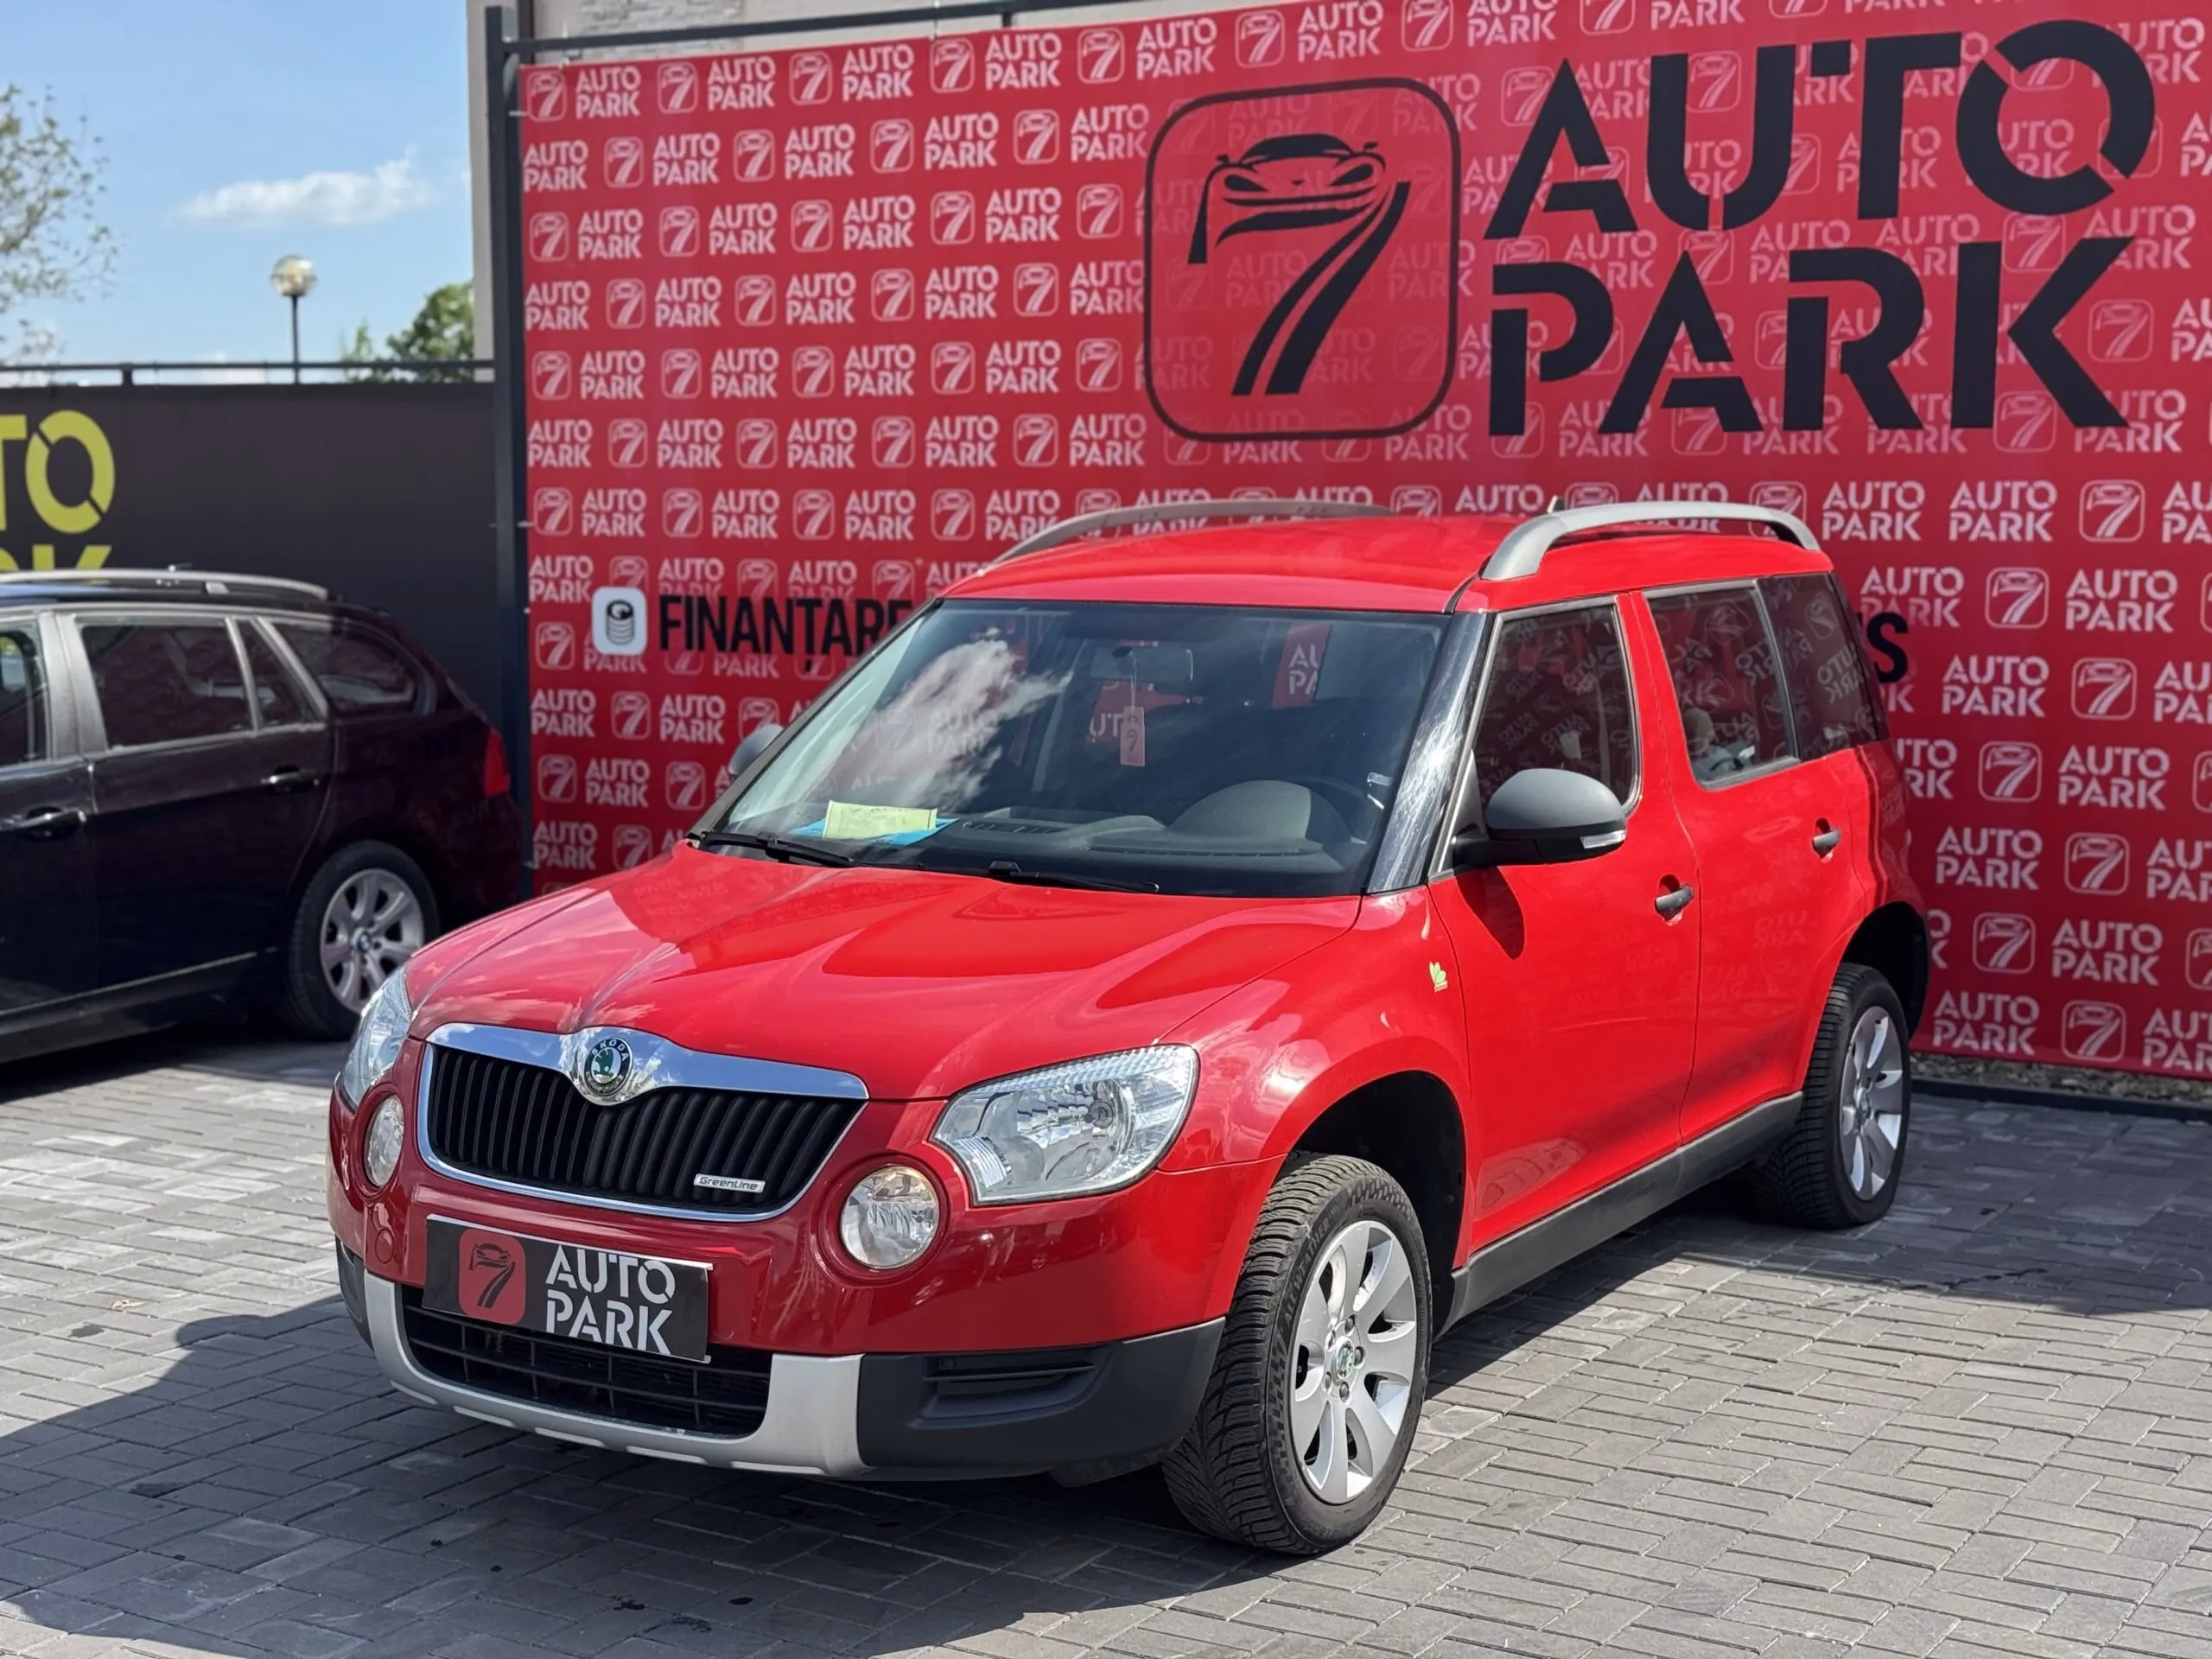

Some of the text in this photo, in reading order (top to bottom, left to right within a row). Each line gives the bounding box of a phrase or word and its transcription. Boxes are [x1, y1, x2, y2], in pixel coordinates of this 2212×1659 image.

[1298, 0, 1382, 36] AUTO
[1468, 10, 1555, 46] PARK
[1650, 1, 1745, 29] PARK
[985, 34, 1061, 62] AUTO
[1136, 18, 1217, 52] AUTO
[1298, 27, 1381, 62] PARK
[708, 57, 776, 85] AUTO
[842, 45, 914, 73] AUTO
[1136, 44, 1216, 79] PARK
[575, 66, 641, 92] AUTO
[842, 73, 914, 101] PARK
[985, 60, 1060, 90] PARK
[575, 91, 641, 118] PARK
[708, 81, 776, 111] PARK
[924, 112, 999, 142] AUTO
[1071, 104, 1148, 133] AUTO
[1483, 19, 2155, 240] AUTO
[653, 133, 720, 161] AUTO
[785, 124, 855, 152] AUTO
[1071, 131, 1147, 162] PARK
[1997, 119, 2074, 151] UTO
[523, 140, 588, 167] AUTO
[785, 150, 855, 180] PARK
[924, 142, 997, 171] PARK
[523, 166, 588, 192] PARK
[653, 159, 719, 187] PARK
[843, 195, 915, 223] AUTO
[985, 187, 1061, 215] AUTO
[578, 210, 643, 235] AUTO
[709, 203, 777, 229] AUTO
[985, 213, 1060, 243] PARK
[1875, 213, 1980, 246] AUTO
[2084, 205, 2196, 237] AUTO
[578, 234, 643, 261] PARK
[709, 227, 777, 255] PARK
[843, 222, 915, 251] PARK
[1565, 232, 1656, 261] AUTO
[1751, 219, 1851, 251] AUTO
[925, 265, 999, 293] AUTO
[1071, 260, 1144, 289] AUTO
[1750, 253, 1789, 283] PA
[525, 281, 590, 308] AUTO
[656, 276, 722, 303] AUTO
[786, 271, 856, 298] AUTO
[656, 302, 721, 328] PARK
[786, 297, 855, 325] PARK
[925, 292, 997, 319] PARK
[1071, 287, 1144, 315] PARK
[2173, 298, 2212, 328] AU
[525, 305, 589, 331] PARK
[1489, 235, 2135, 436] PARK
[2171, 332, 2212, 362] PA
[581, 351, 645, 375] AUTO
[710, 348, 779, 374] AUTO
[844, 345, 915, 372] AUTO
[985, 341, 1061, 367] AUTO
[581, 375, 645, 399] PARK
[710, 373, 779, 399] PARK
[844, 371, 915, 397] PARK
[985, 366, 1060, 393] PARK
[527, 420, 593, 444] AUTO
[658, 418, 723, 442] AUTO
[787, 417, 856, 442] AUTO
[925, 415, 998, 440] AUTO
[1070, 414, 1146, 440] AUTO
[1743, 426, 1840, 454] PARK
[1867, 424, 1967, 454] PARK
[2075, 426, 2182, 454] PARK
[527, 443, 592, 468] PARK
[658, 442, 722, 468] PARK
[787, 442, 856, 468] PARK
[925, 441, 997, 467] PARK
[1070, 440, 1144, 467] PARK
[1224, 440, 1302, 464] PARK
[1384, 434, 1469, 461] PARK
[1560, 432, 1649, 458] PARK
[582, 489, 646, 513] AUTO
[712, 489, 779, 513] AUTO
[845, 489, 916, 515] AUTO
[986, 489, 1060, 515] AUTO
[1455, 484, 1544, 512] AUTO
[1822, 481, 1925, 511] AUTO
[1949, 480, 2056, 511] AUTO
[2162, 480, 2212, 512] AU
[582, 512, 646, 537] PARK
[712, 513, 779, 539] PARK
[845, 514, 915, 542] PARK
[1822, 512, 1921, 541] PARK
[1949, 512, 2053, 542] PARK
[2162, 512, 2212, 543] PA
[530, 556, 593, 579] AUTO
[658, 557, 724, 583] AUTO
[788, 560, 857, 585] AUTO
[530, 579, 589, 602] PARK
[1860, 567, 1964, 597] AUTO
[2066, 569, 2178, 600] AUTO
[2065, 601, 2174, 632] PARK
[714, 654, 779, 678] PARK
[1943, 656, 2049, 685] AUTO
[2154, 661, 2212, 691] AU
[531, 690, 596, 714] AUTO
[660, 695, 726, 719] AUTO
[1942, 687, 2047, 717] PARK
[2154, 692, 2212, 723] PA
[531, 713, 595, 737] PARK
[660, 718, 724, 744] PARK
[585, 759, 650, 784] AUTO
[2058, 746, 2171, 778] AUTO
[586, 782, 649, 807] PARK
[1904, 768, 1955, 799] RK
[2058, 776, 2166, 810] PARK
[533, 821, 598, 846] AUTO
[1936, 826, 2043, 859] AUTO
[532, 844, 596, 870] PARK
[1936, 856, 2039, 890] PARK
[2051, 918, 2163, 953] AUTO
[2052, 949, 2159, 986] PARK
[1934, 990, 2040, 1025] AUTO
[1933, 1019, 2036, 1055] PARK
[2142, 1039, 2212, 1072] PAR
[699, 1176, 758, 1191] GreenLine
[545, 1244, 676, 1305] AUTO
[545, 1289, 672, 1355] PARK
